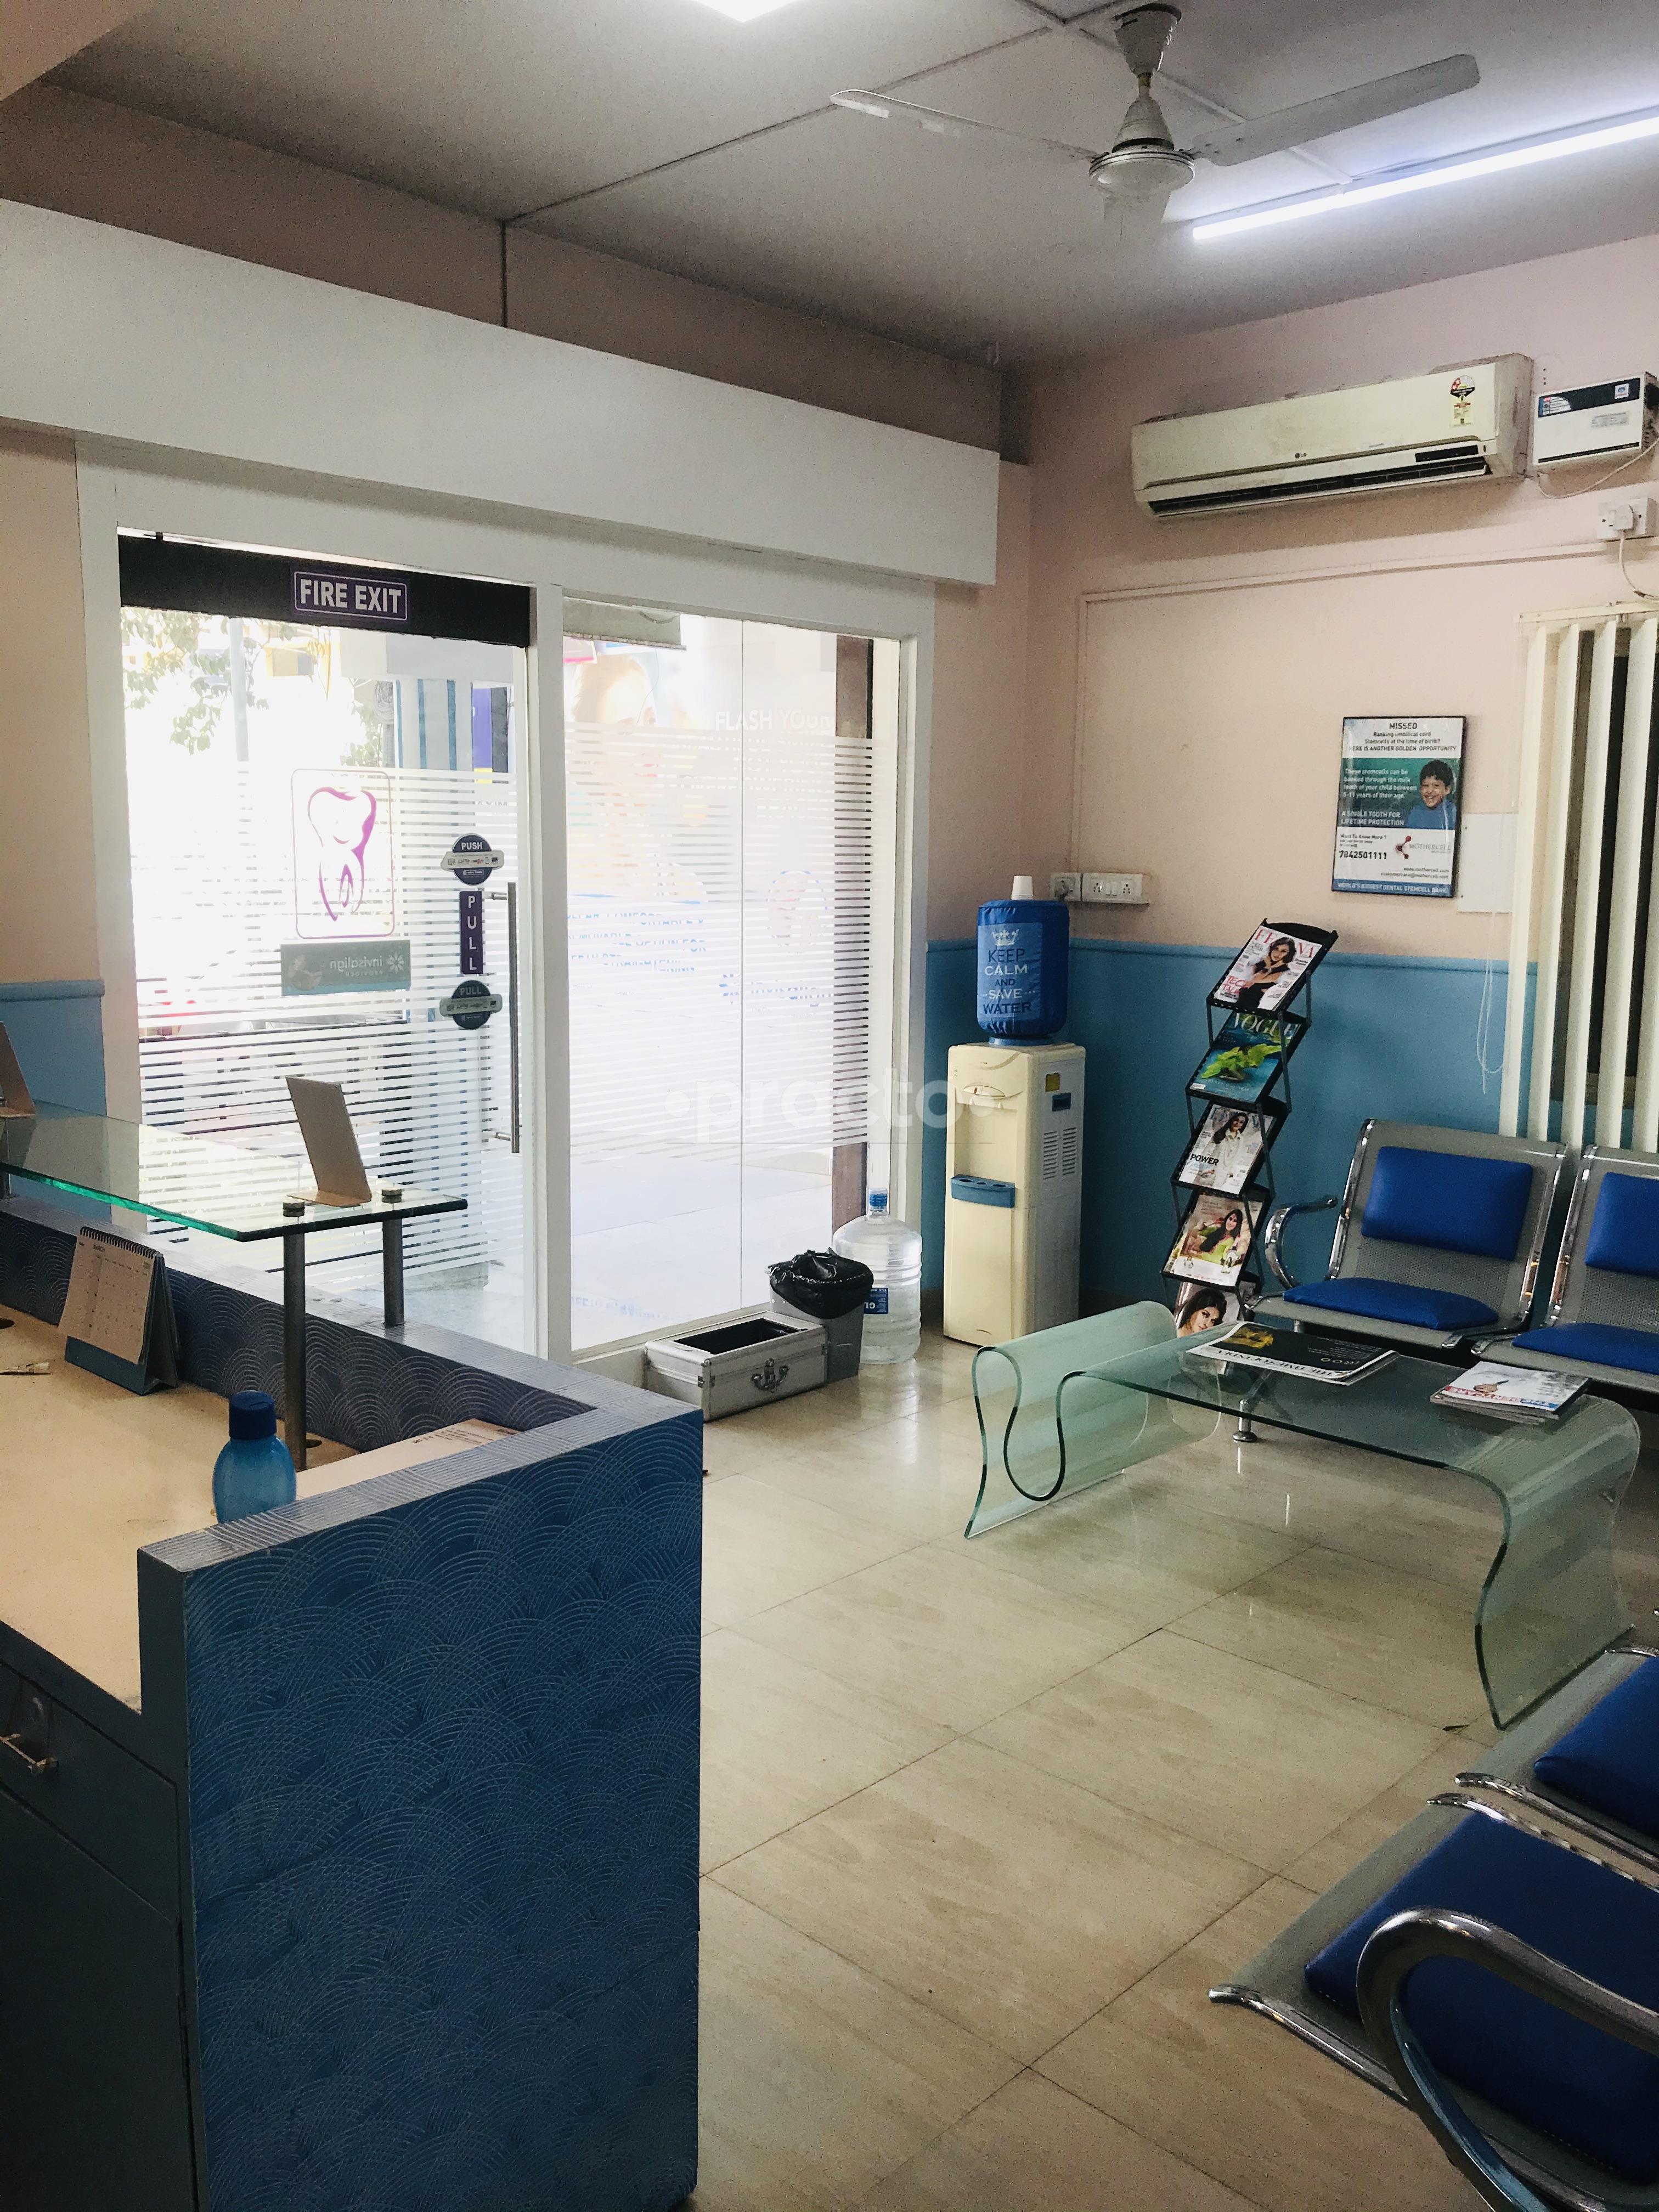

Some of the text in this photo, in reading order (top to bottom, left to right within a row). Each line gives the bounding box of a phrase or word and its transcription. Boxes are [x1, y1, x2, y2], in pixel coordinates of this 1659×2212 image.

[300, 579, 402, 614] FIRE EXIT
[715, 710, 772, 731] FLASH
[461, 842, 483, 850] PUSH
[1339, 850, 1387, 860] 7842501111
[467, 895, 477, 970] PULL
[988, 947, 1025, 963] KEEP
[984, 964, 1028, 977] CALM
[994, 978, 1015, 986] AND
[460, 986, 482, 996] PULL
[989, 989, 1023, 1000] SAVE
[983, 1001, 1032, 1015] WATER
[1190, 1153, 1219, 1166] POWER
